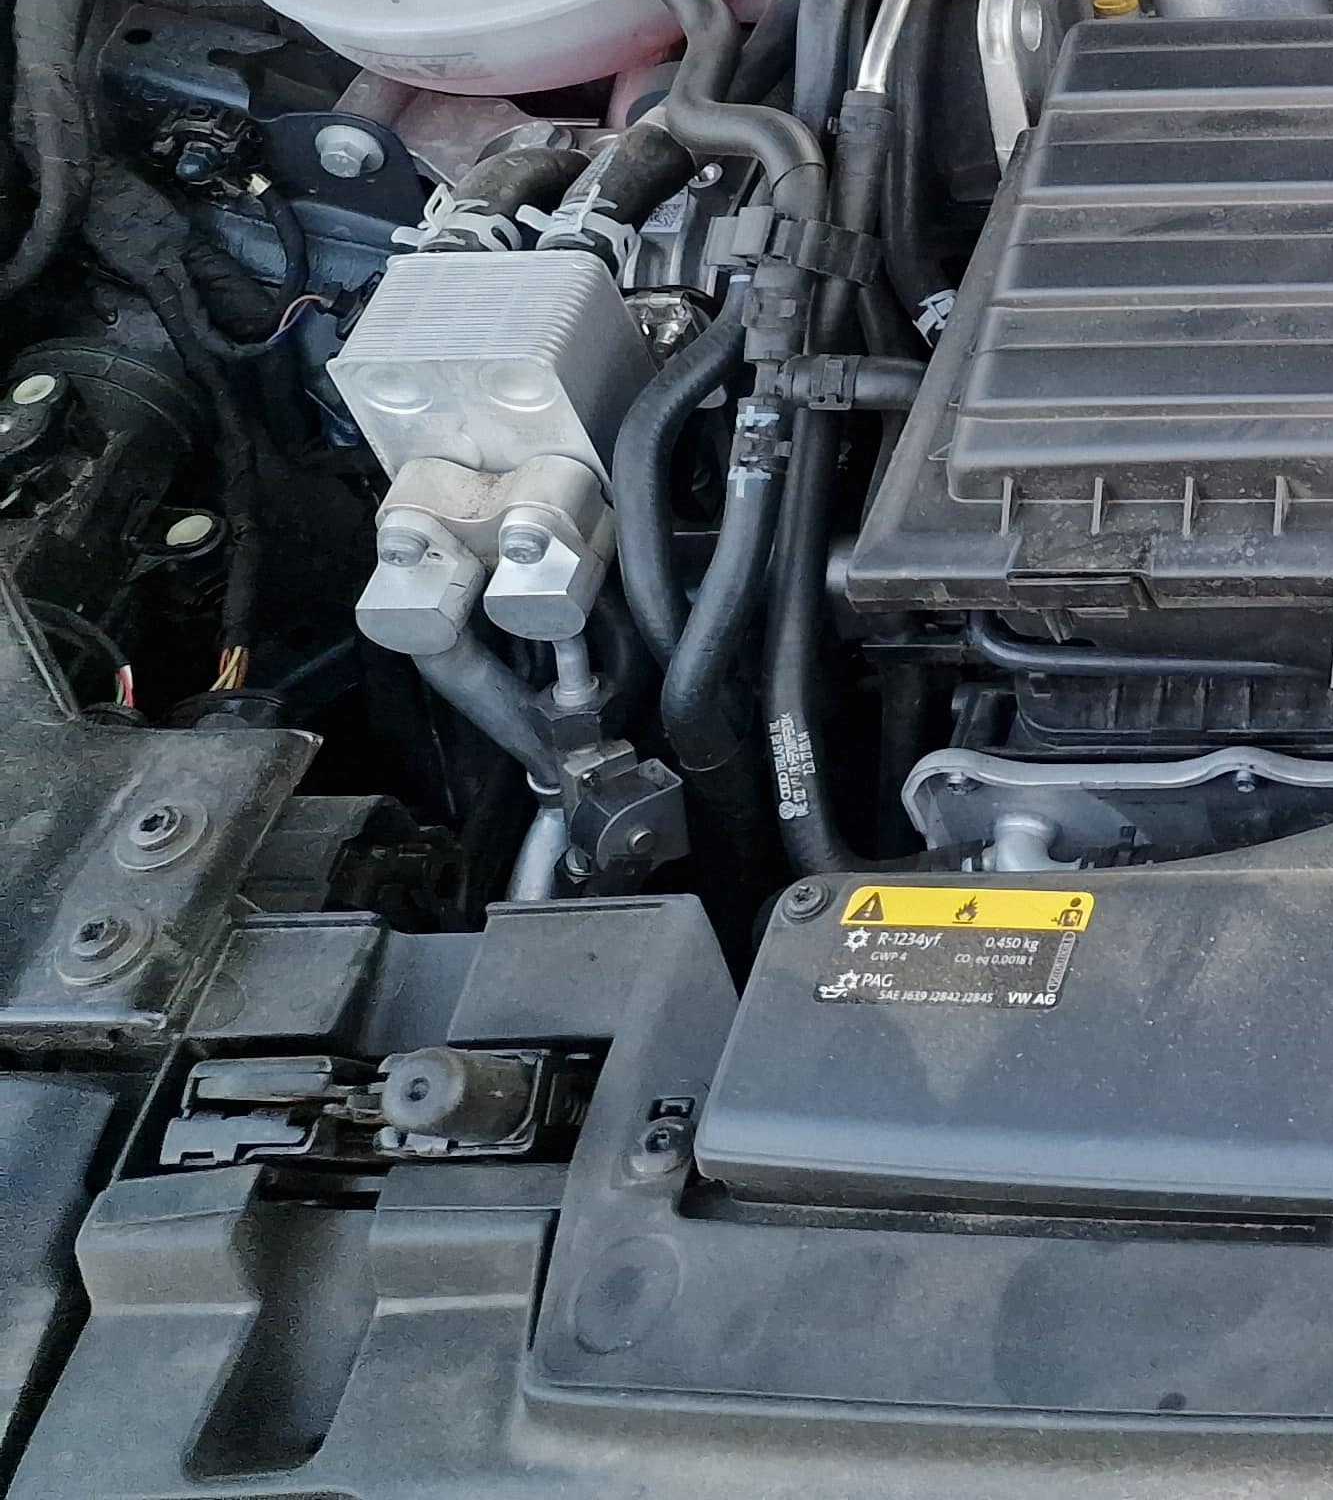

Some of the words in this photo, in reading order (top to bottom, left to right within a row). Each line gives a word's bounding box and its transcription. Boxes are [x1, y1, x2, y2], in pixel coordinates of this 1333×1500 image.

[877, 932, 943, 947] R-1234yf
[1022, 937, 1039, 952] kg
[870, 952, 898, 962] GWP
[861, 973, 896, 988] PAG
[877, 990, 900, 1000] SAE
[1007, 992, 1032, 1005] VW
[1032, 993, 1057, 1006] AG
